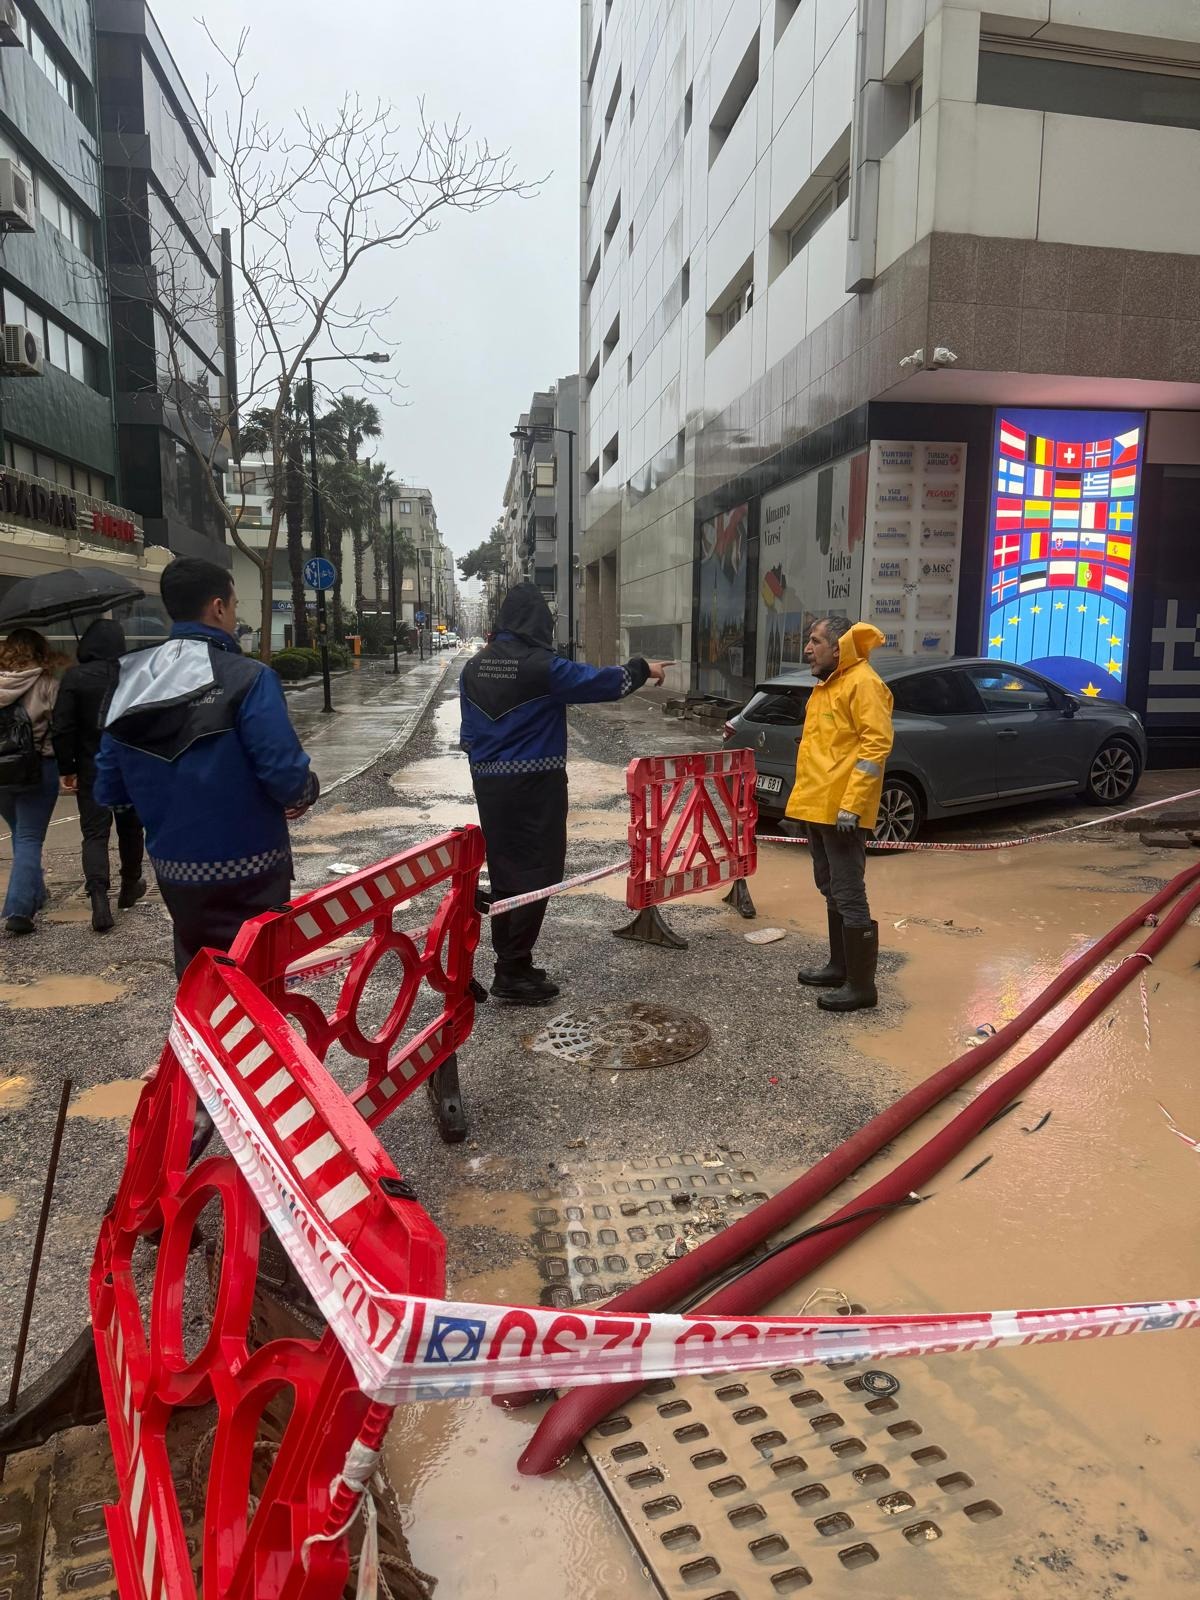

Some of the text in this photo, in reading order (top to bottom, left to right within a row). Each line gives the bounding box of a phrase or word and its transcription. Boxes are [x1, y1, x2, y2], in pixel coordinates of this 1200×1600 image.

[926, 489, 956, 498] PEGASUS
[765, 502, 791, 523] Almanya
[763, 525, 782, 547] Vizesi
[829, 547, 852, 577] İtalya
[932, 564, 952, 573] MSC
[826, 578, 851, 599] Vizesi
